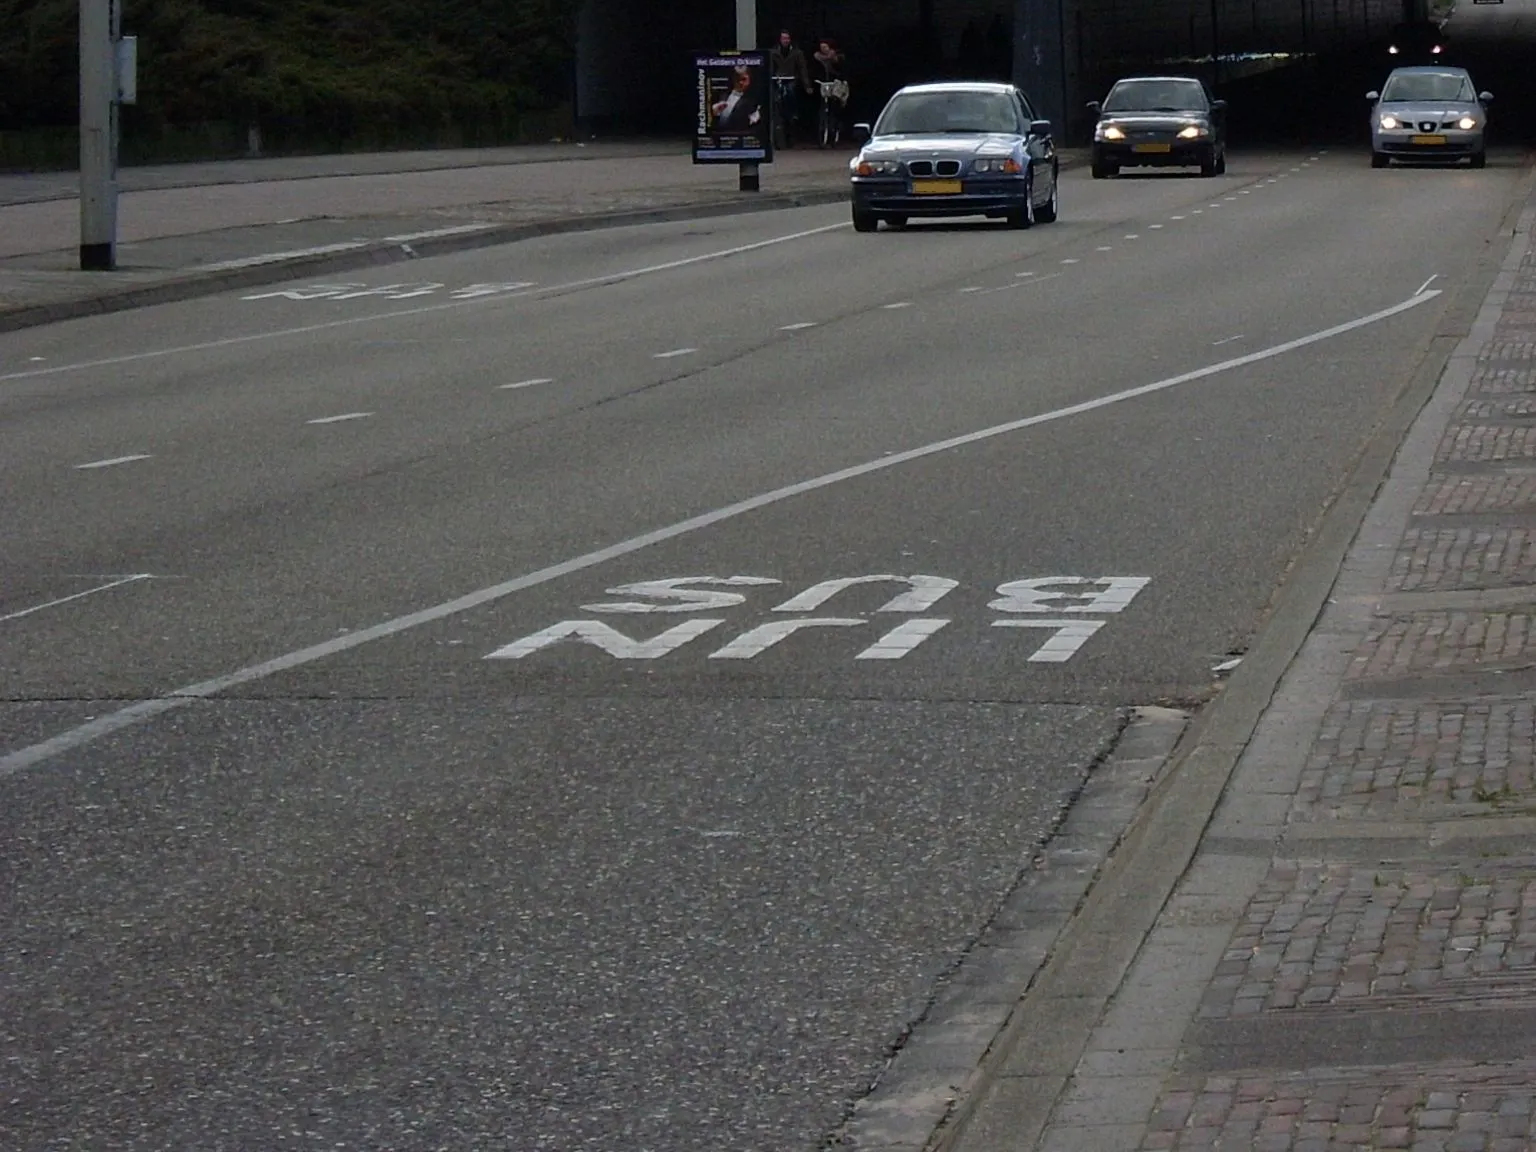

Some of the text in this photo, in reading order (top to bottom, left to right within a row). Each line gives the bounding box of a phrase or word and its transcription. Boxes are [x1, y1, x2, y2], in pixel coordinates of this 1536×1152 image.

[697, 68, 706, 134] Rachmaninov
[580, 573, 1151, 613] BUS
[482, 618, 1107, 662] LIJN
